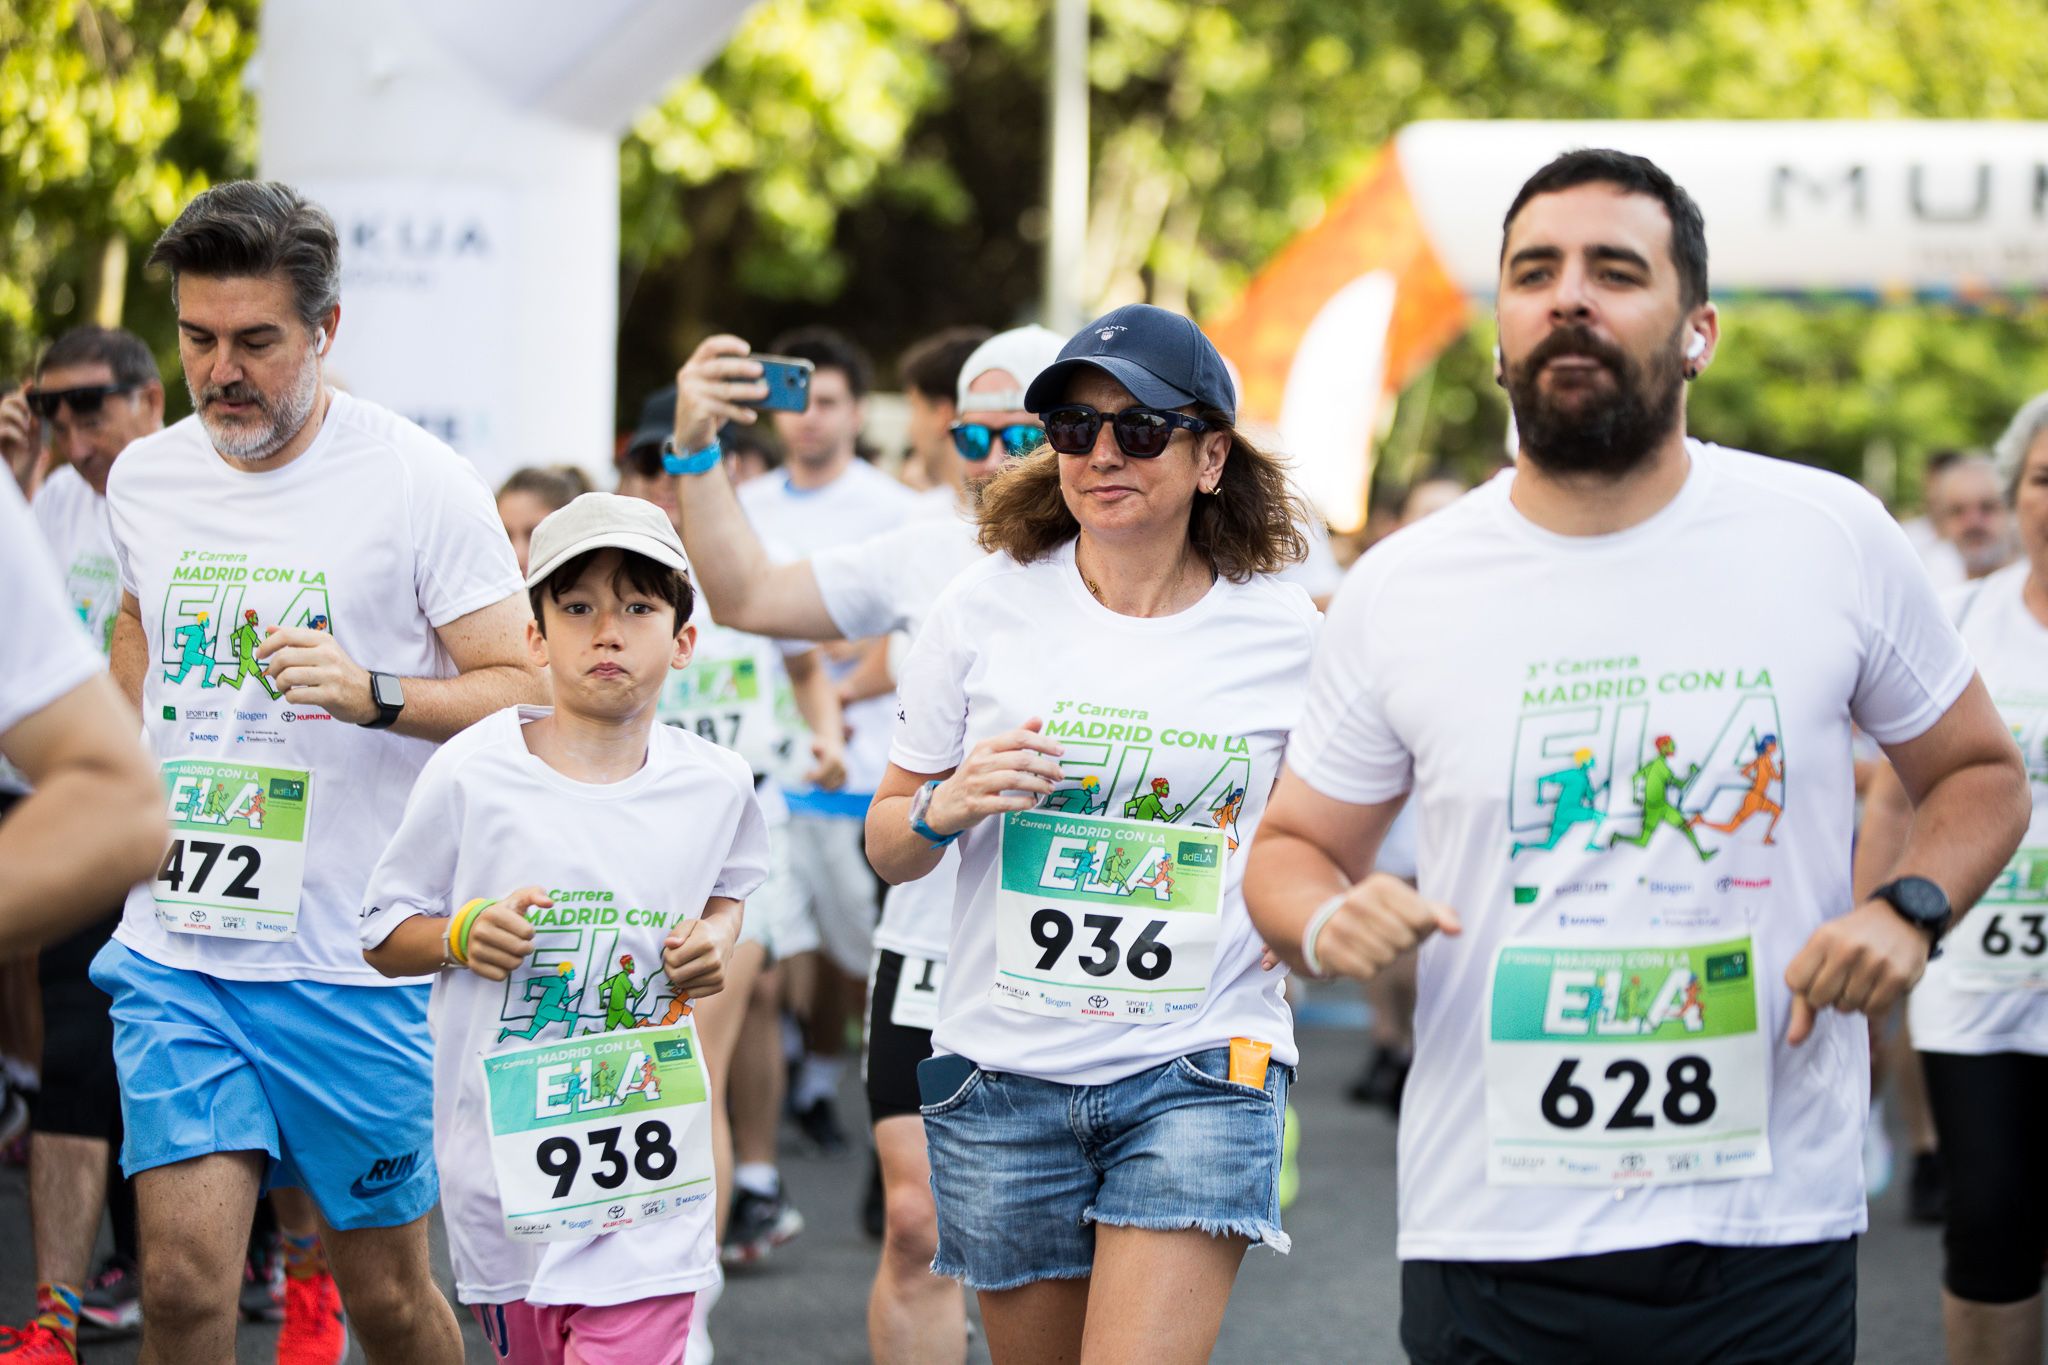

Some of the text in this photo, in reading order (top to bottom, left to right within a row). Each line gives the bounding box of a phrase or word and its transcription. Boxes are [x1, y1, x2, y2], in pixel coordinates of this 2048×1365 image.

[198, 551, 248, 562] Carrera
[173, 566, 326, 586] MADRID CON LA
[1555, 655, 1640, 677] Carrera
[1522, 666, 1773, 708] MADRID CON LA
[236, 711, 268, 721] Biogen
[1077, 703, 1149, 720] Carrera
[195, 734, 219, 742] MADRID
[664, 713, 742, 746] 87
[1045, 719, 1250, 754] MADRID CON LA
[178, 764, 215, 776] MADRID
[216, 768, 242, 779] CON
[244, 771, 260, 782] LA
[1507, 693, 1788, 836] ELA
[166, 775, 263, 829] ELA
[1020, 819, 1052, 830] Carrera
[1054, 823, 1112, 838] MADRID
[1115, 829, 1145, 843] CON
[1148, 833, 1166, 844] LA
[157, 839, 262, 900] 472
[1038, 835, 1171, 901] ELA
[1182, 852, 1212, 864] adELA
[549, 888, 615, 902] Carrera
[263, 924, 288, 933] MADRID
[523, 907, 620, 927] MADRID
[625, 909, 669, 929] CON
[1030, 908, 1172, 981] 936
[1044, 995, 1072, 1008] Biogen
[1172, 1003, 1199, 1012] MADRID
[1128, 1007, 1146, 1015] LIFE
[1543, 967, 1706, 1036] ELA
[536, 1046, 592, 1066] MADRID
[594, 1041, 624, 1056] CON
[626, 1039, 644, 1052] LA
[535, 1050, 662, 1119] ELA
[1541, 1055, 1717, 1130] 628
[366, 1150, 420, 1181] RUN
[536, 1120, 678, 1199] 938
